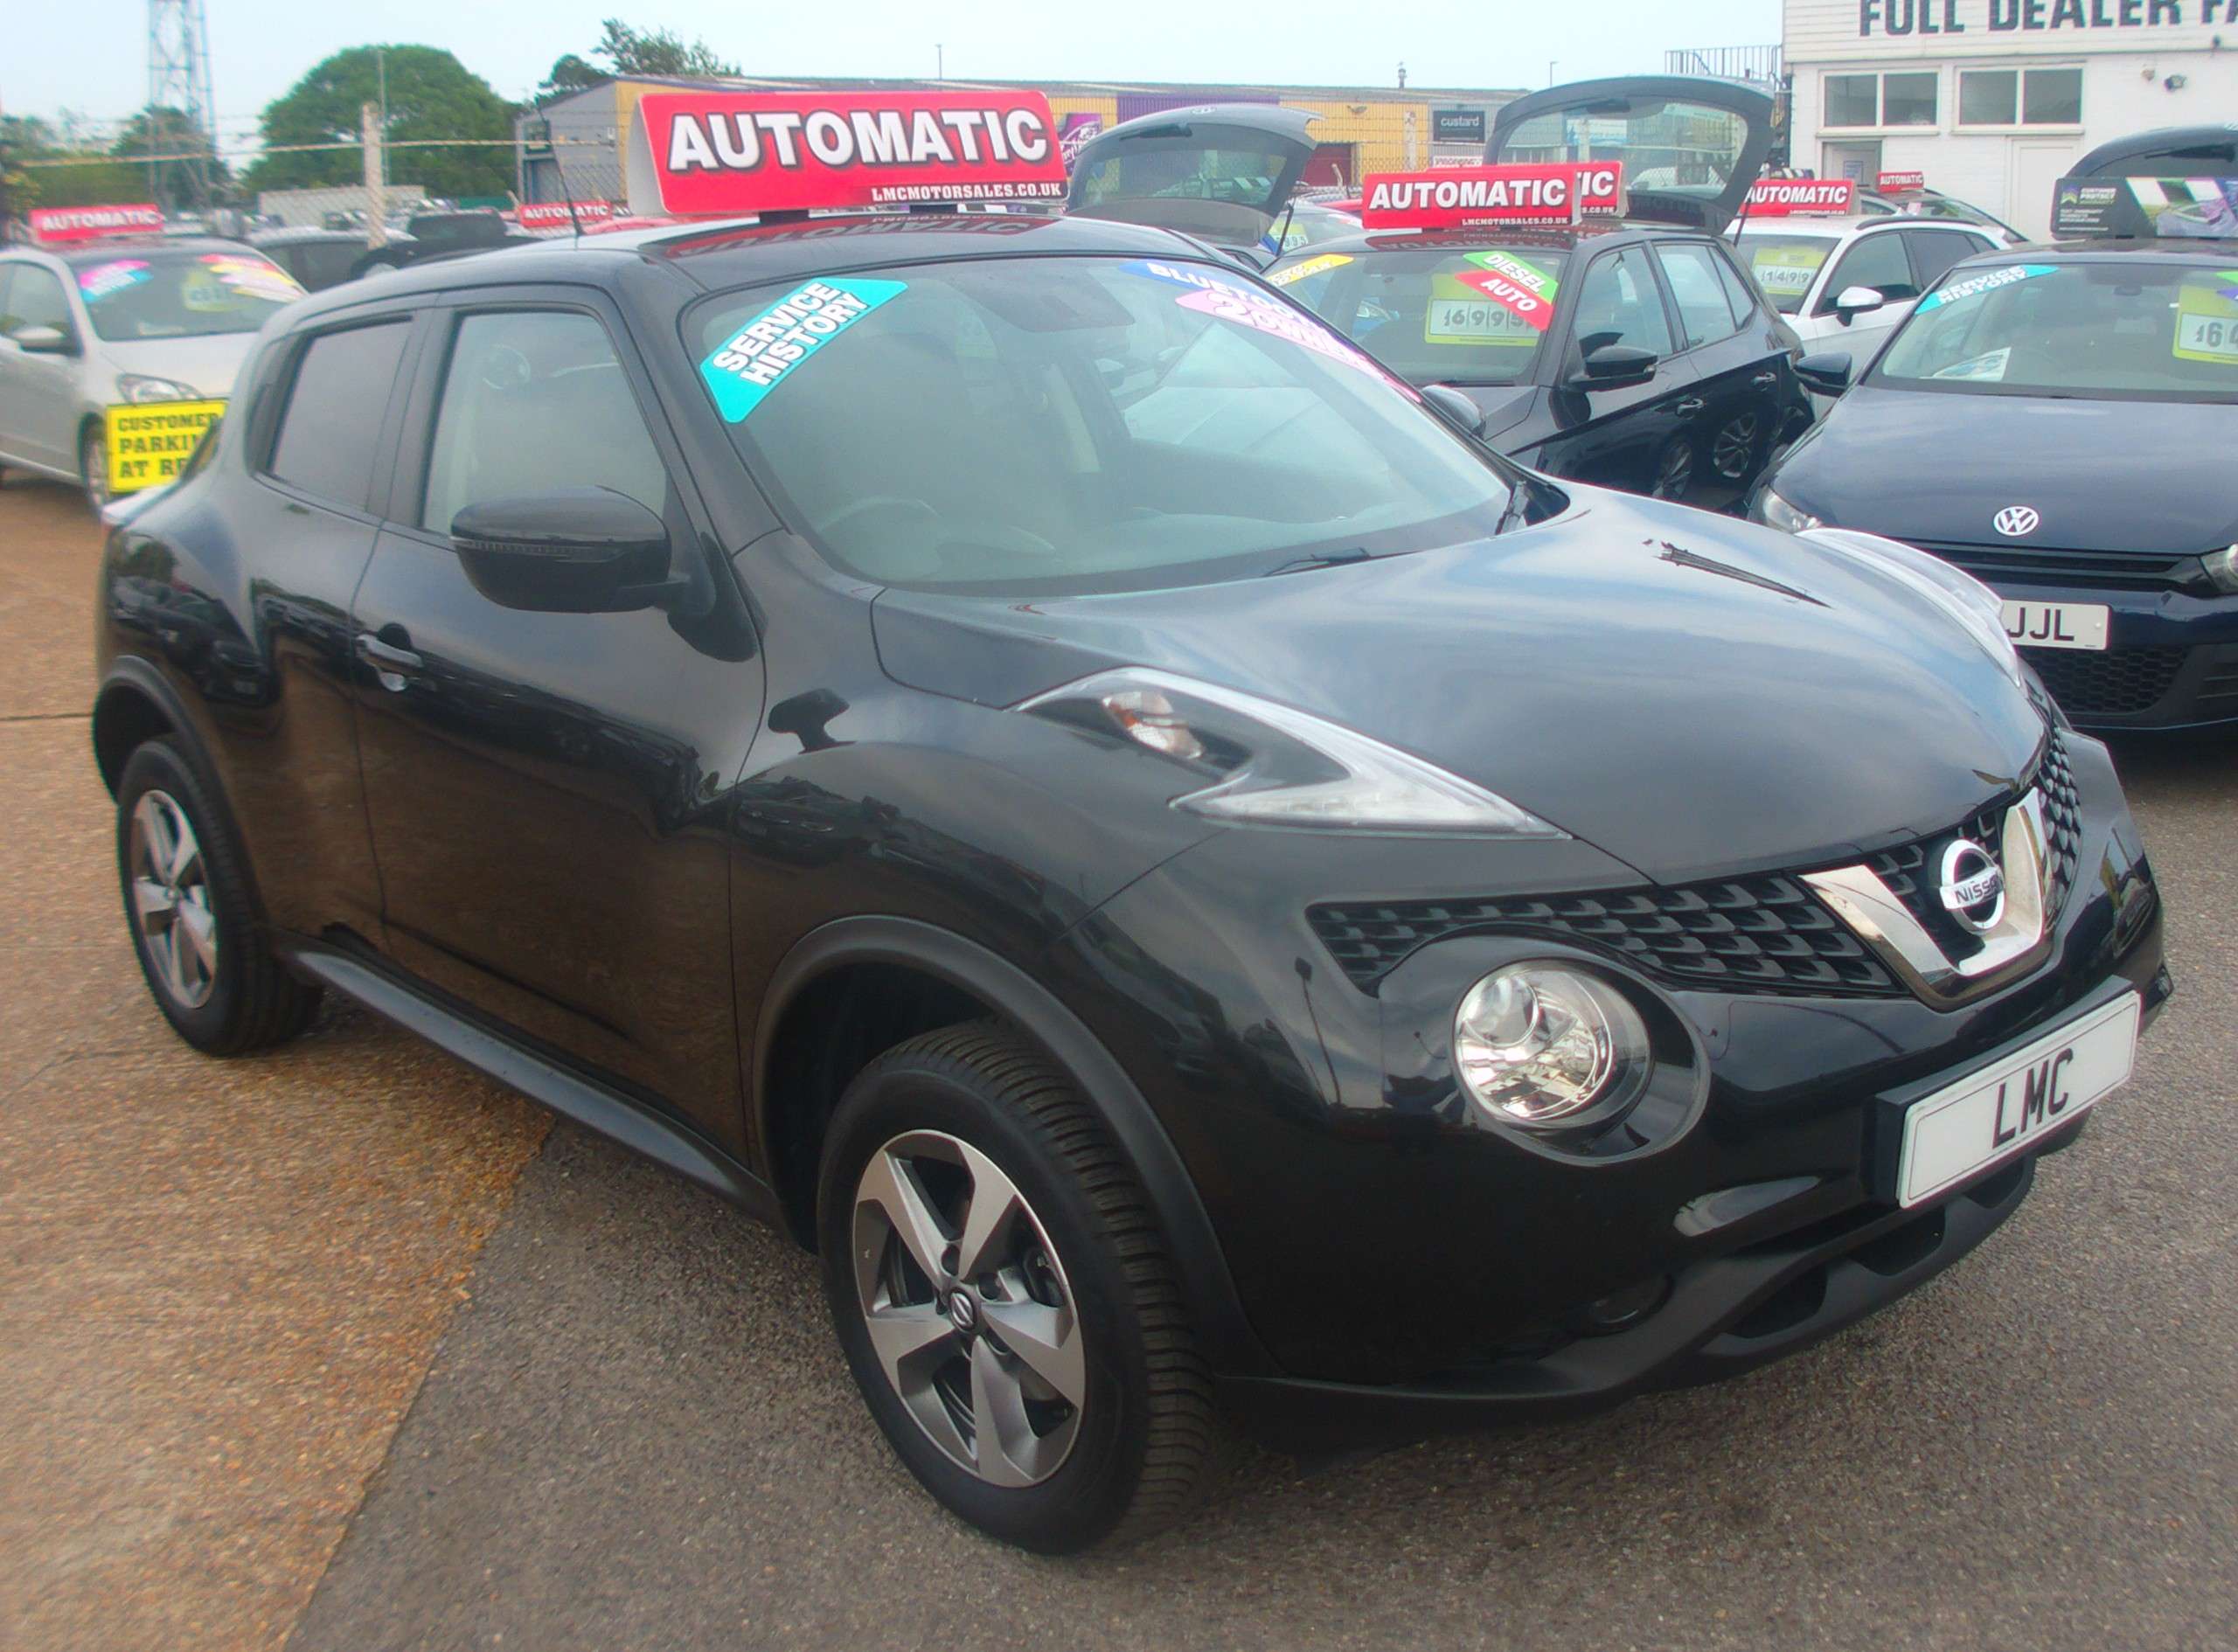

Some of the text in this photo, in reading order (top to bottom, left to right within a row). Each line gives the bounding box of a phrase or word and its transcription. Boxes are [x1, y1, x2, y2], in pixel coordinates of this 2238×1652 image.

[1860, 0, 1964, 37] FULL
[1989, 0, 2182, 31] DEALER
[668, 109, 1048, 172] AUTOMATIC
[872, 183, 1062, 202] LMCMOTORSALES.CO.UK
[1368, 178, 1567, 211] AUTOMATIC
[1744, 185, 1848, 204] AUTOMATIC
[1880, 174, 1924, 186] AUTOMATIC
[42, 210, 161, 231] AUTOMATIC
[1483, 253, 1546, 293] DIESEL
[1480, 278, 1538, 312] AUTO
[712, 281, 842, 372] SERVICE
[740, 292, 869, 386] HISTORY
[119, 460, 149, 478] AT
[1991, 1047, 2074, 1150] LMC
